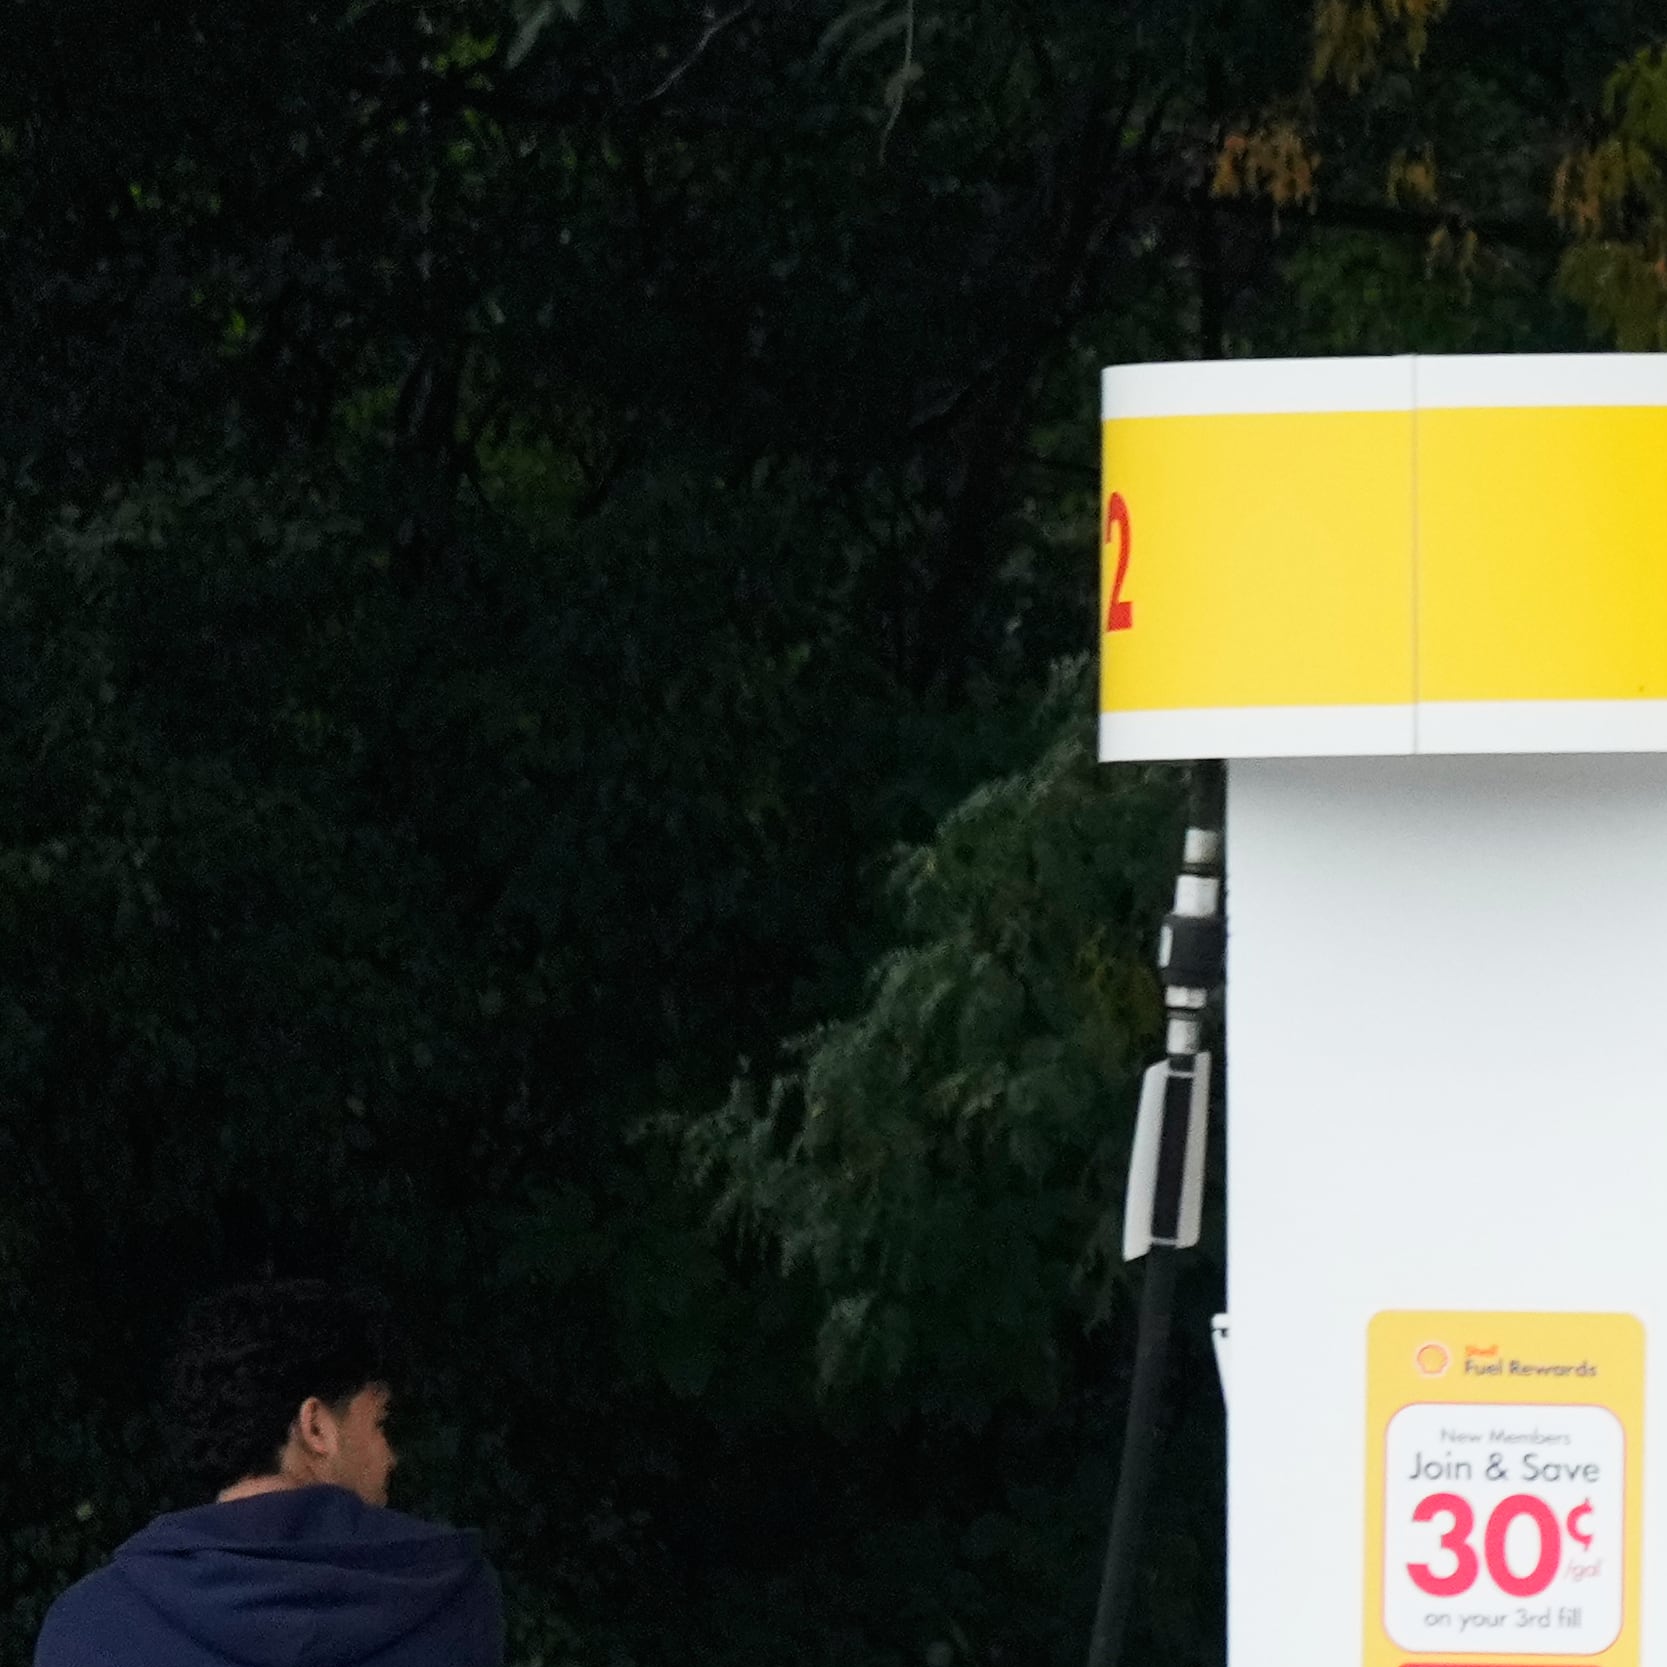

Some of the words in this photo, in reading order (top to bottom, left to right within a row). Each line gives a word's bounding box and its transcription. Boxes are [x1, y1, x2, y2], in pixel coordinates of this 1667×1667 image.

[1105, 491, 1132, 632] 2
[1465, 1360, 1503, 1376] Fuel
[1510, 1359, 1597, 1377] Rewards
[1441, 1428, 1482, 1443] New
[1490, 1427, 1571, 1445] Members
[1409, 1452, 1472, 1482] Join
[1485, 1452, 1508, 1481] &
[1523, 1452, 1601, 1483] Save
[1424, 1611, 1451, 1628] on
[1459, 1611, 1507, 1633] your
[1515, 1607, 1550, 1629] 3rd
[1557, 1606, 1582, 1628] fill
